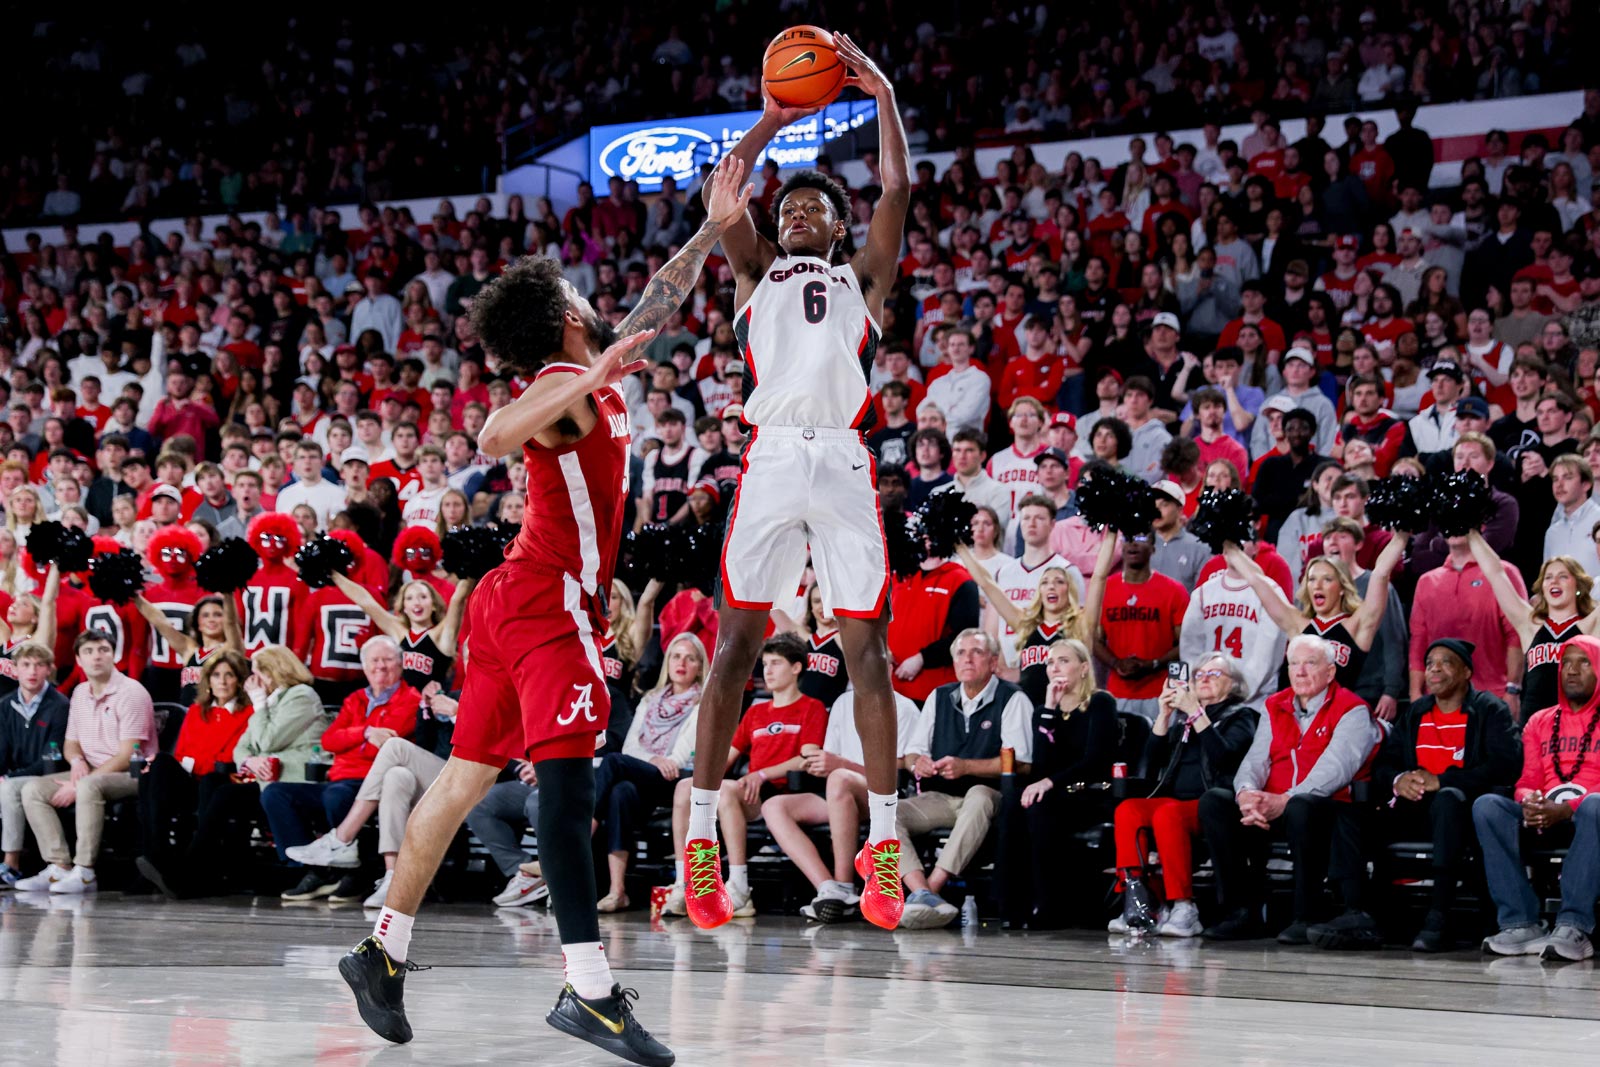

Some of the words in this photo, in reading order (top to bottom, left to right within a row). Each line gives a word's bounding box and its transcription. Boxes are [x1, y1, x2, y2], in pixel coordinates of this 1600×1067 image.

[620, 135, 697, 175] Ford
[803, 281, 827, 324] 6
[1106, 607, 1160, 623] GEORGIA
[1203, 602, 1259, 624] GEORGIA
[1214, 625, 1244, 659] 14
[557, 683, 597, 726] A
